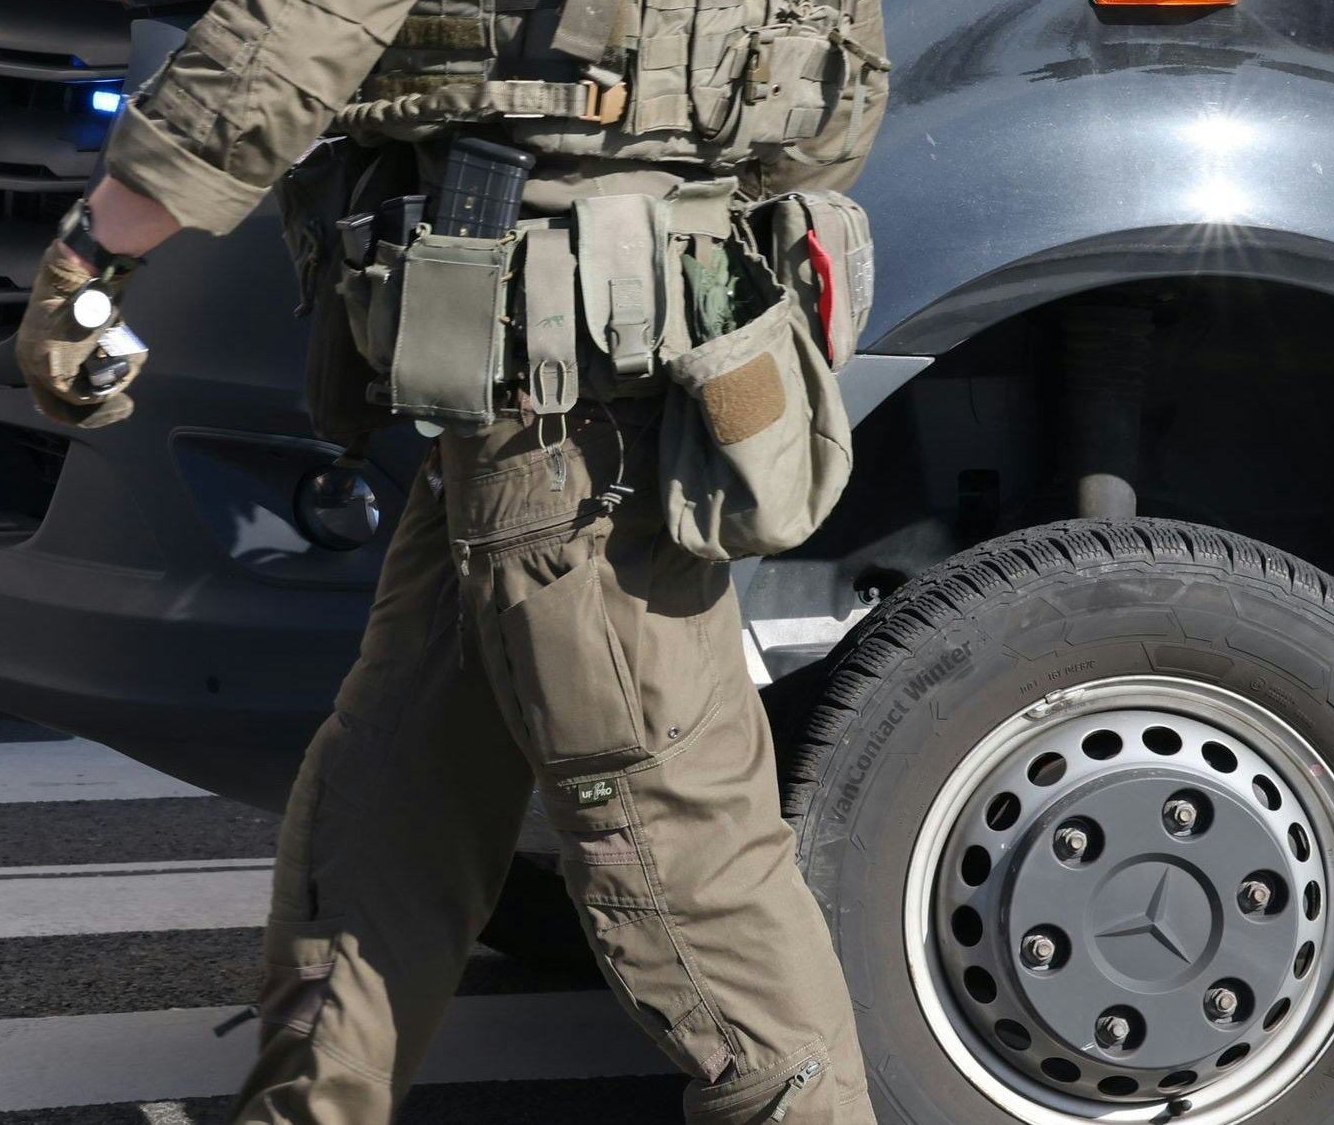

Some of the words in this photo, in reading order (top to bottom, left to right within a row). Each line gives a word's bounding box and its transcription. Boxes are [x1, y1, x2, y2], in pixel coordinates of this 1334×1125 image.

[827, 698, 910, 825] VanContact
[902, 640, 973, 702] Winter
[581, 789, 593, 799] UF
[596, 786, 613, 797] PRO
